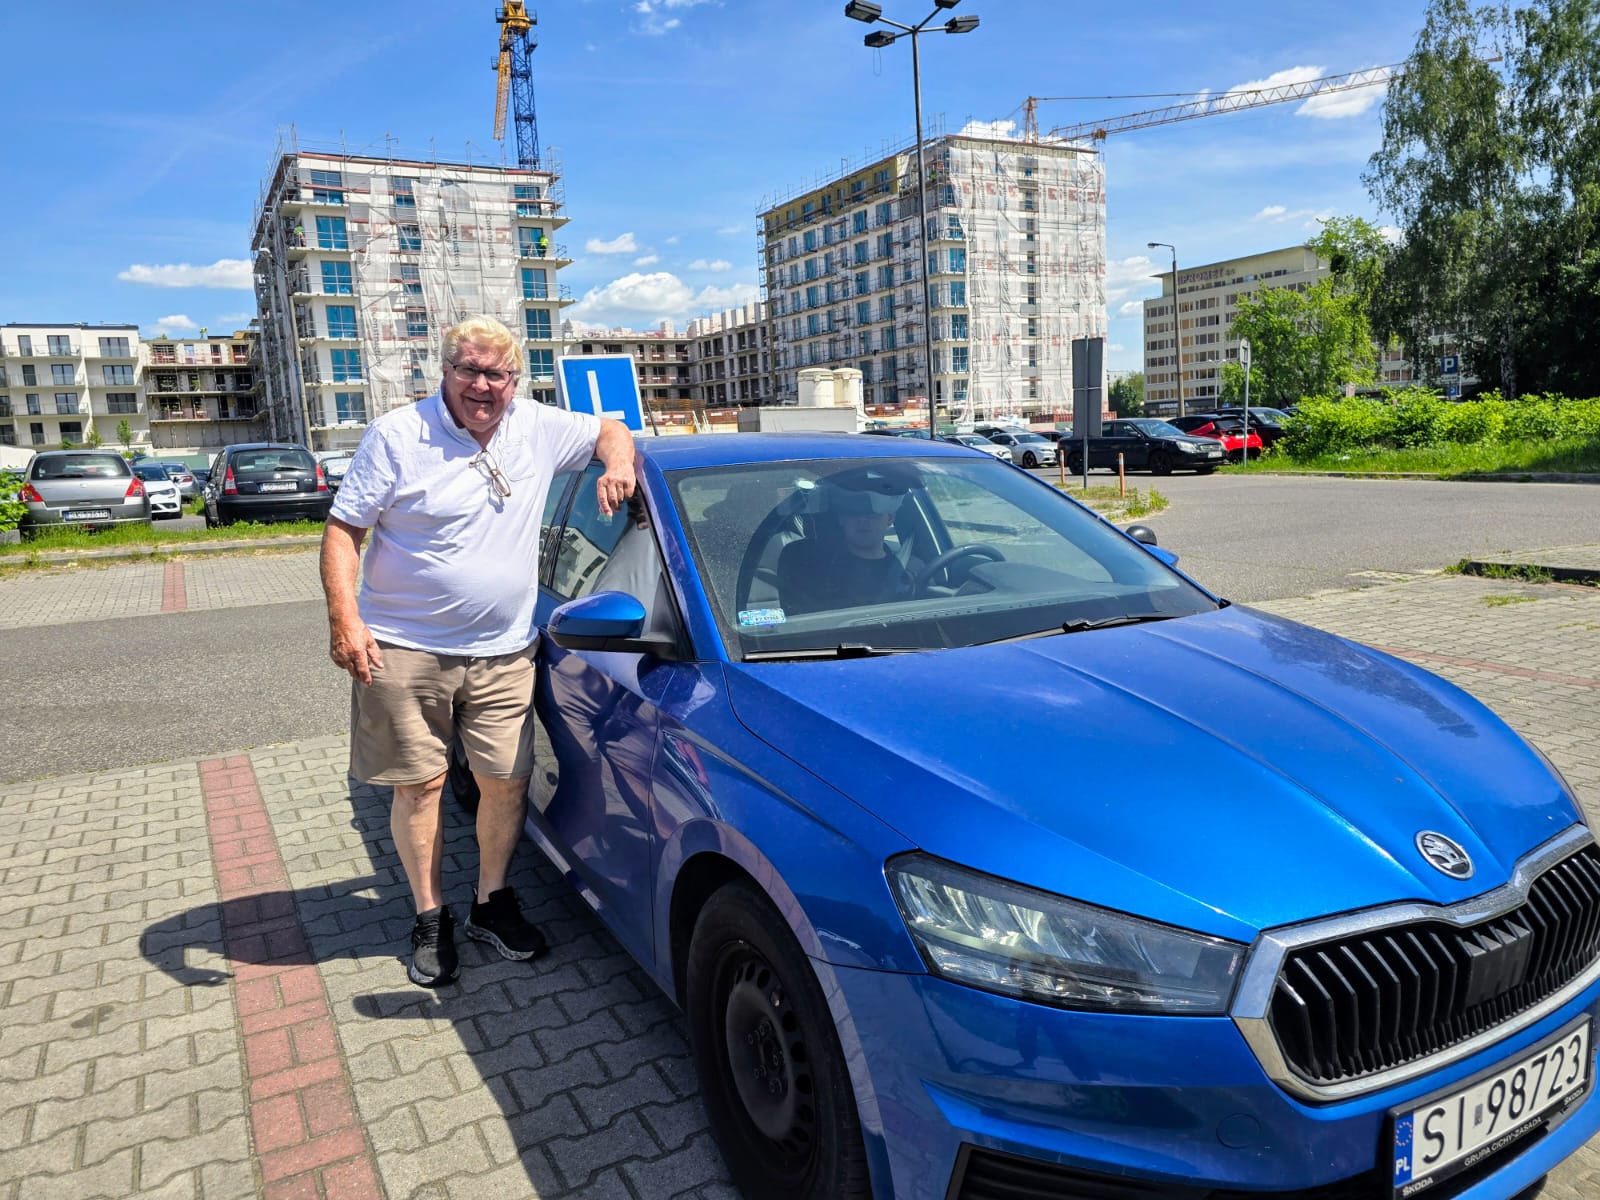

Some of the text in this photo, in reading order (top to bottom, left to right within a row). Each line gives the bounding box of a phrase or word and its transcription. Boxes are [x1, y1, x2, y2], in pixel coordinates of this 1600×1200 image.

[1444, 358, 1455, 372] P
[586, 370, 626, 420] L
[1422, 1034, 1582, 1164] SI 98723
[1395, 1157, 1410, 1176] PL
[1464, 1147, 1490, 1167] GRUPA
